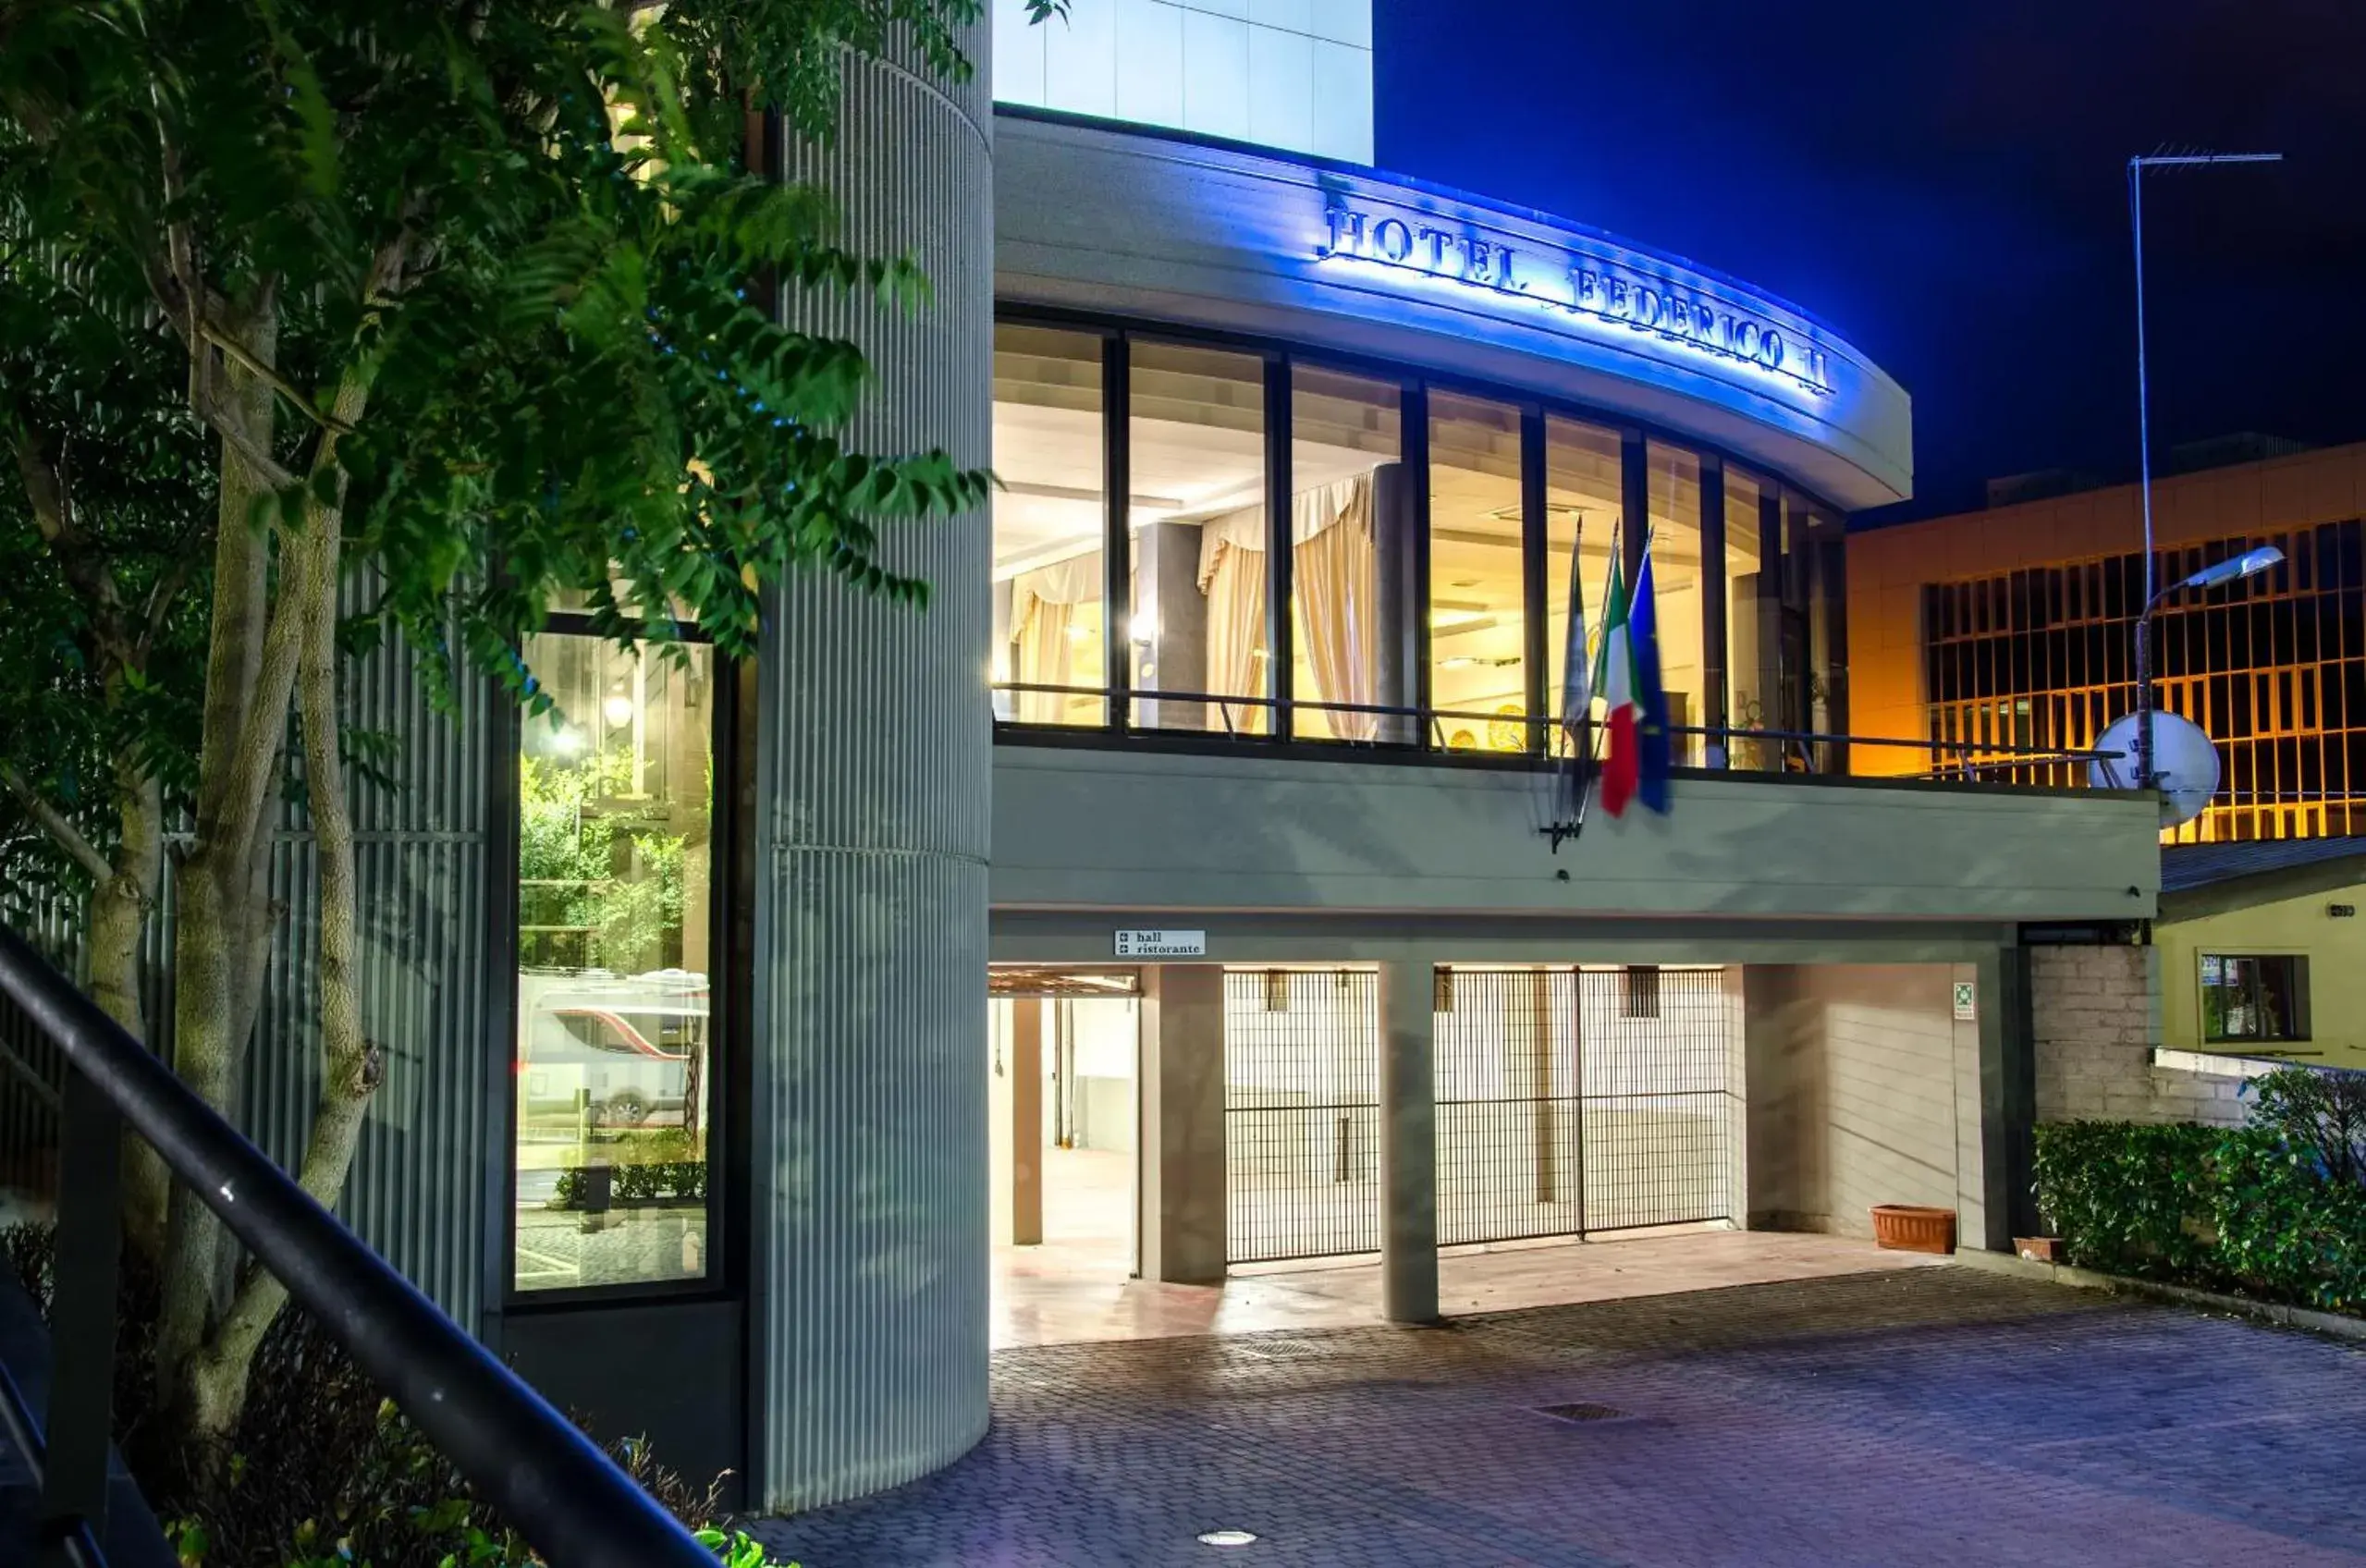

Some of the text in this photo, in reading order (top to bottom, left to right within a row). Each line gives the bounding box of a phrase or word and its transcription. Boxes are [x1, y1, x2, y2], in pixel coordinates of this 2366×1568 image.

[1324, 208, 1832, 390] HOTEL FEDERICO II
[1136, 931, 1161, 942] hall
[1136, 944, 1200, 953] ristorante
